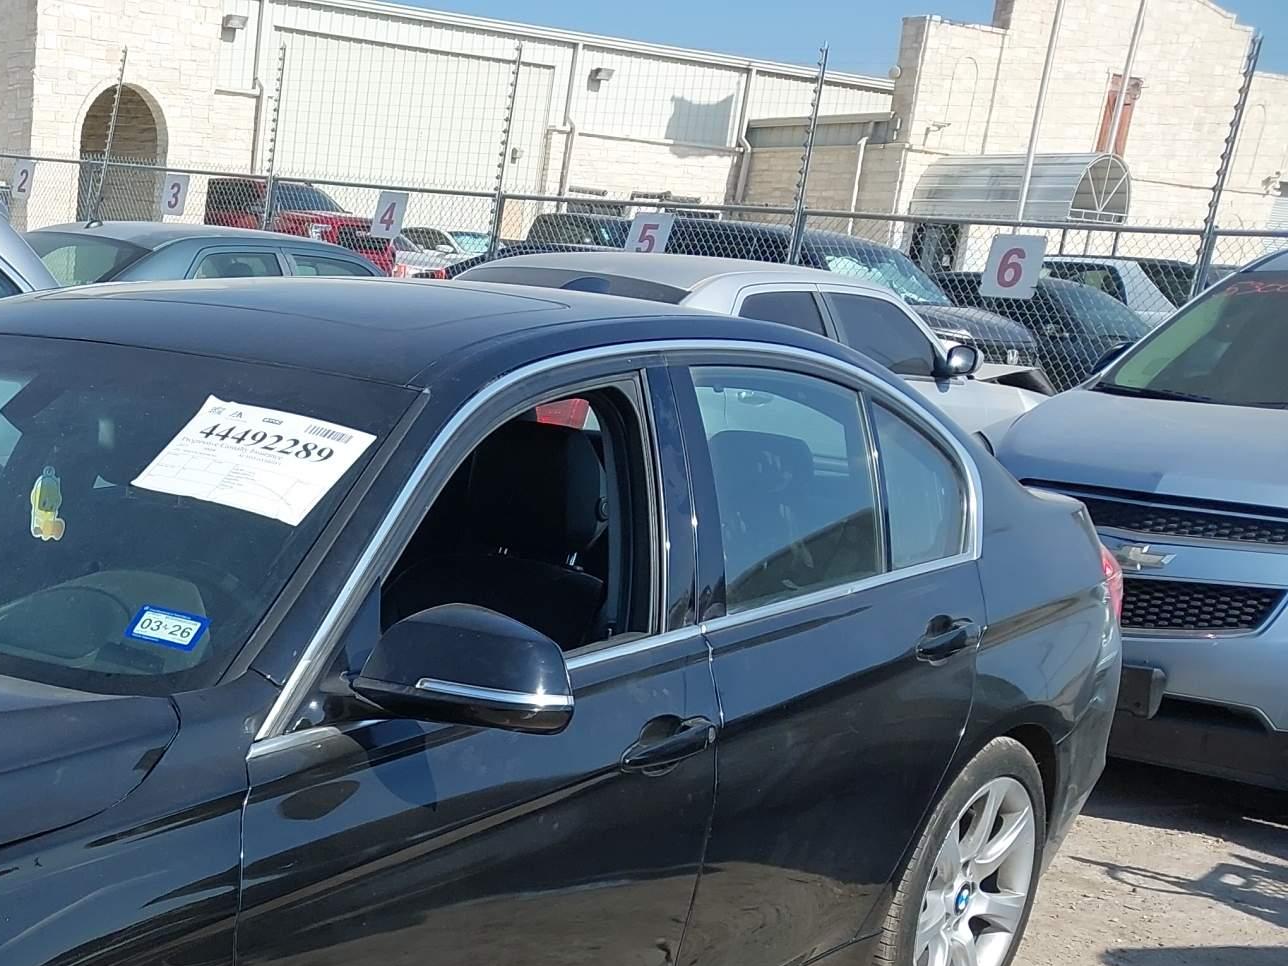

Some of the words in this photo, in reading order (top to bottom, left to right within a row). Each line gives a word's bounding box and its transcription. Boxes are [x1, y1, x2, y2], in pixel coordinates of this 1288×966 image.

[17, 168, 29, 193] 2
[167, 182, 181, 209] 3
[379, 202, 397, 231] 4
[636, 223, 660, 253] 5
[996, 247, 1027, 288] 6
[199, 422, 334, 463] 44492289
[140, 618, 163, 632] 03
[168, 624, 193, 639] 26
